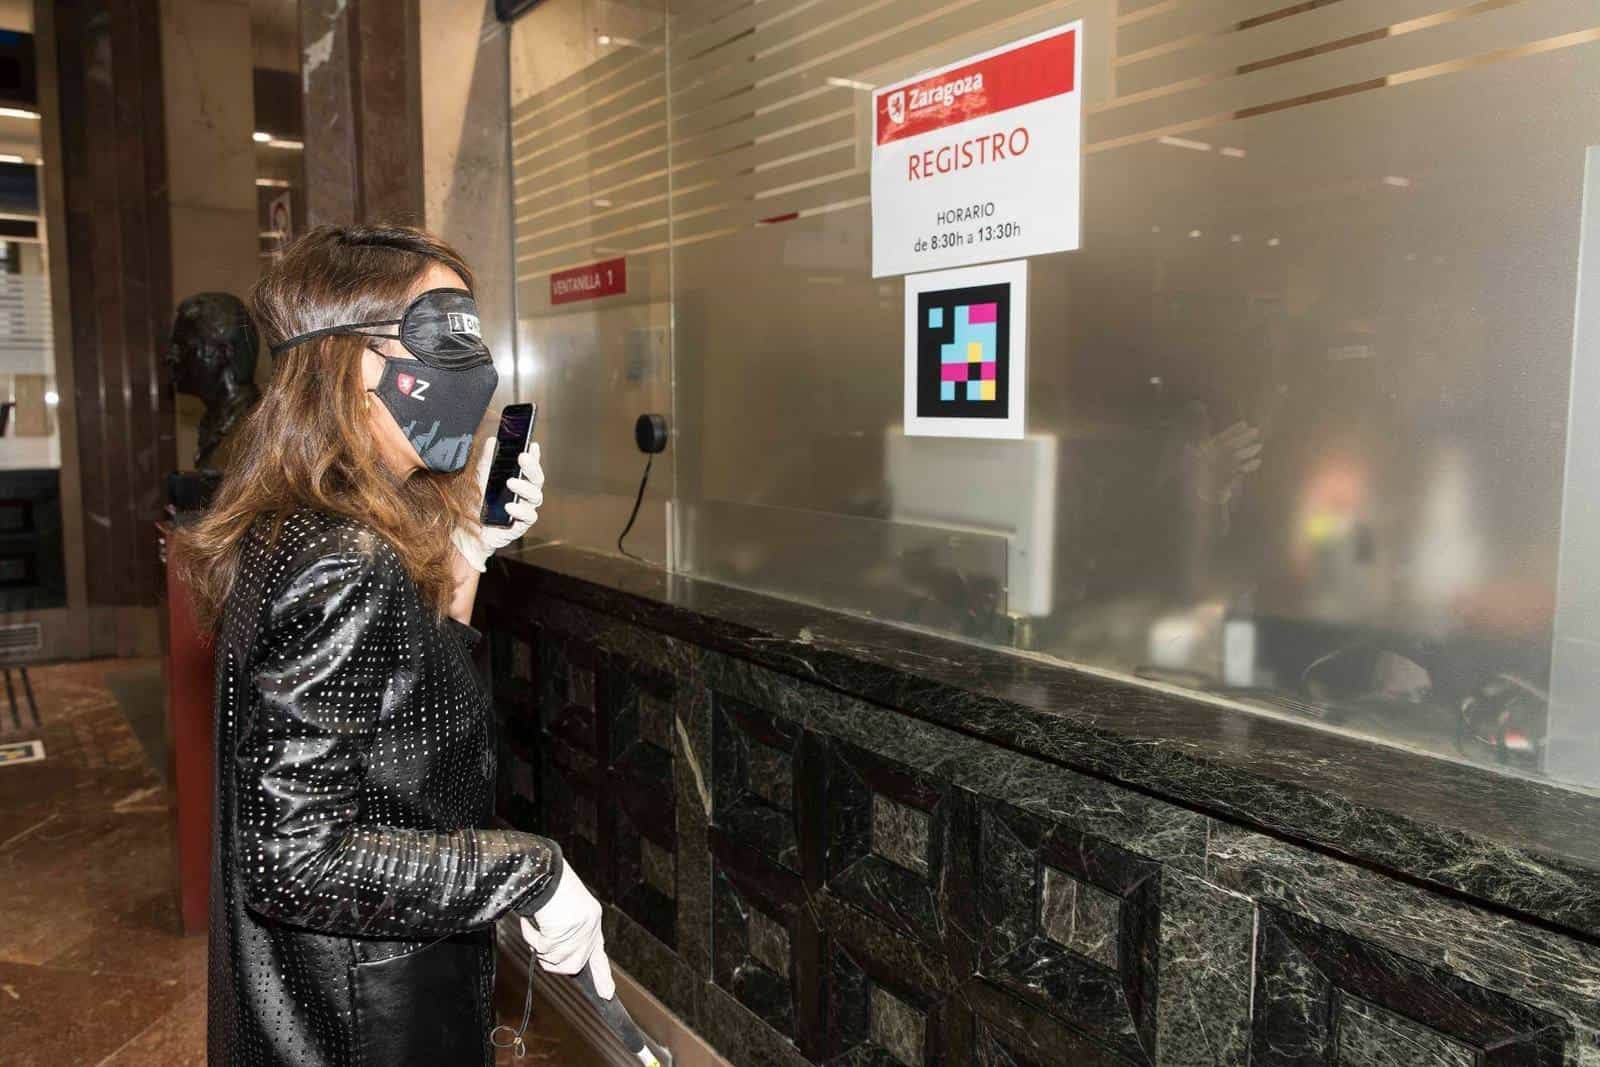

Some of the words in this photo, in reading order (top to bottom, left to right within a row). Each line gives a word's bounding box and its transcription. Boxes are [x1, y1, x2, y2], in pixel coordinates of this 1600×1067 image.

[909, 72, 984, 110] Zaragoza
[908, 126, 1030, 182] REGISTRO
[936, 202, 995, 225] HORARIO
[913, 237, 928, 252] de
[930, 230, 964, 249] 8:30h
[967, 232, 974, 243] a
[978, 222, 1021, 243] 13:30h
[607, 269, 614, 286] 1
[411, 379, 430, 401] Z
